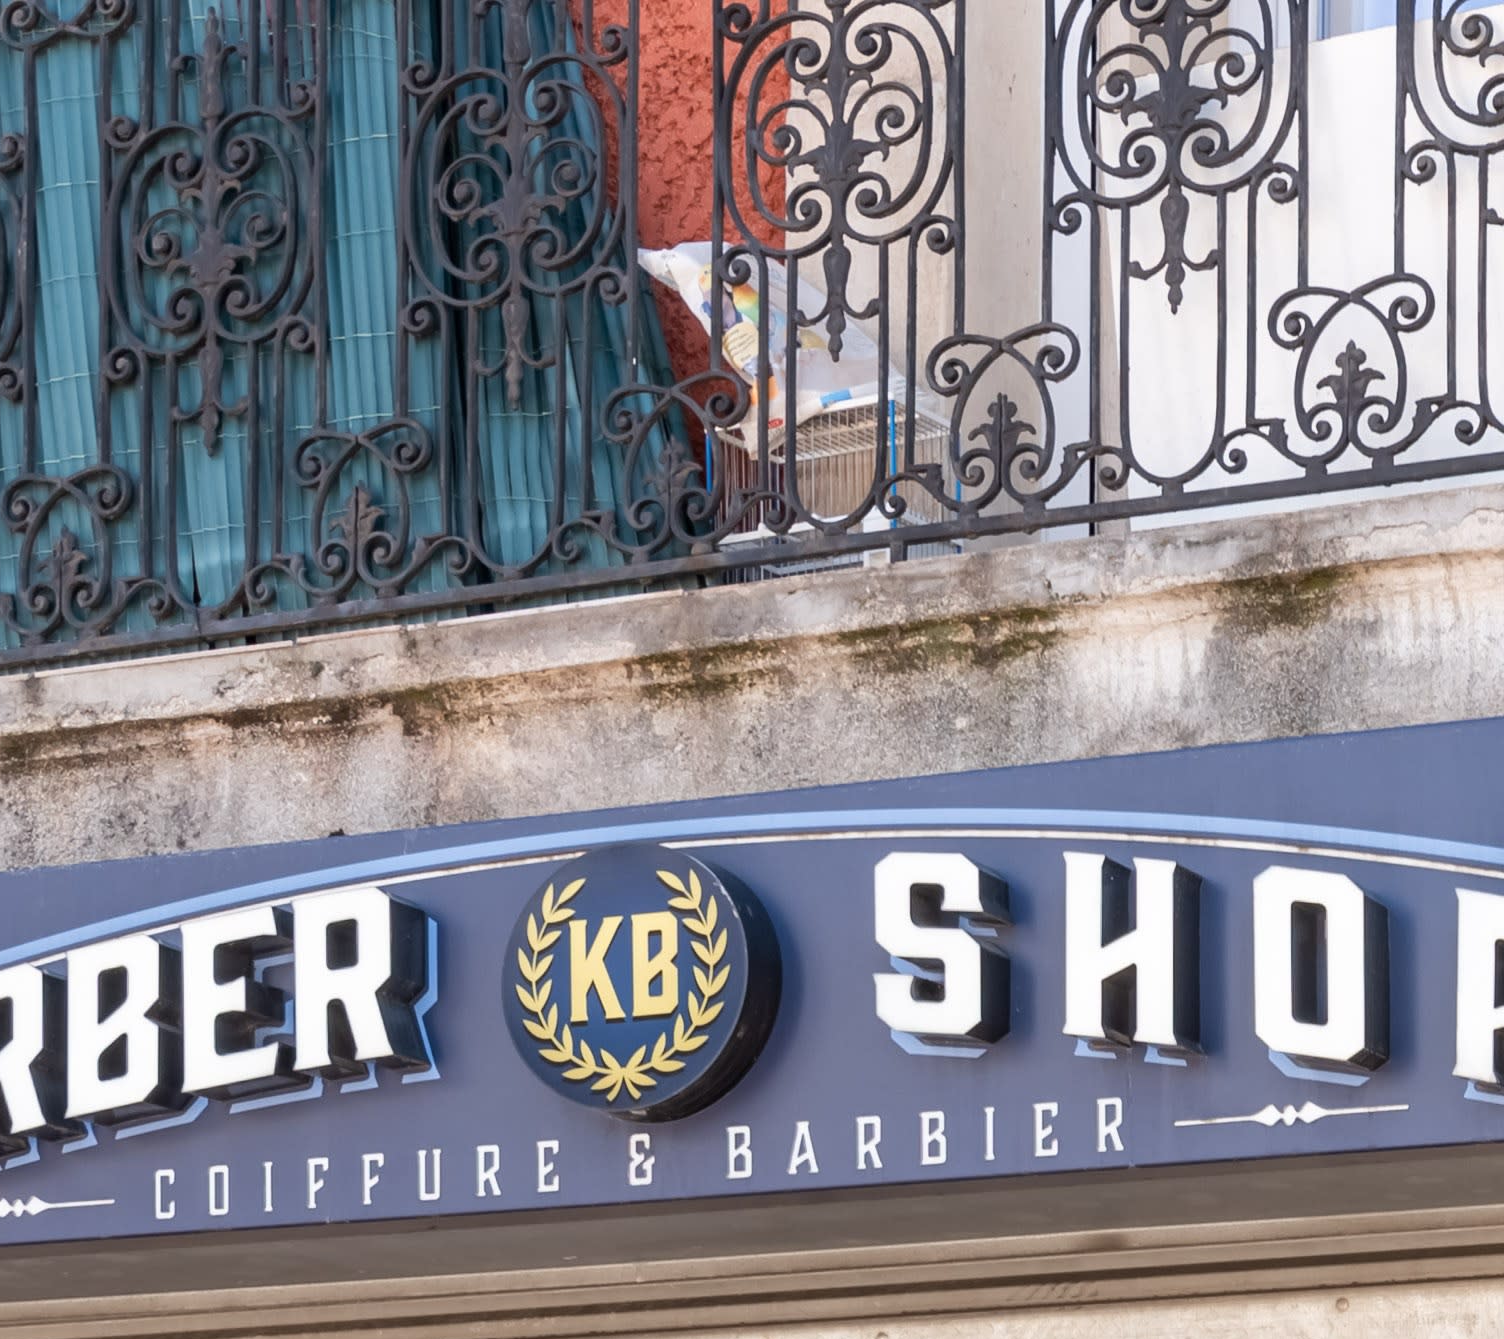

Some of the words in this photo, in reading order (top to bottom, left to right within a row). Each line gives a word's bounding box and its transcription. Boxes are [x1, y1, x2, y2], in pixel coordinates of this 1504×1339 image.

[566, 908, 680, 1025] KB
[154, 1139, 560, 1220] COIFFURE
[628, 1134, 656, 1186] &
[727, 1097, 1126, 1179] BARBIER
